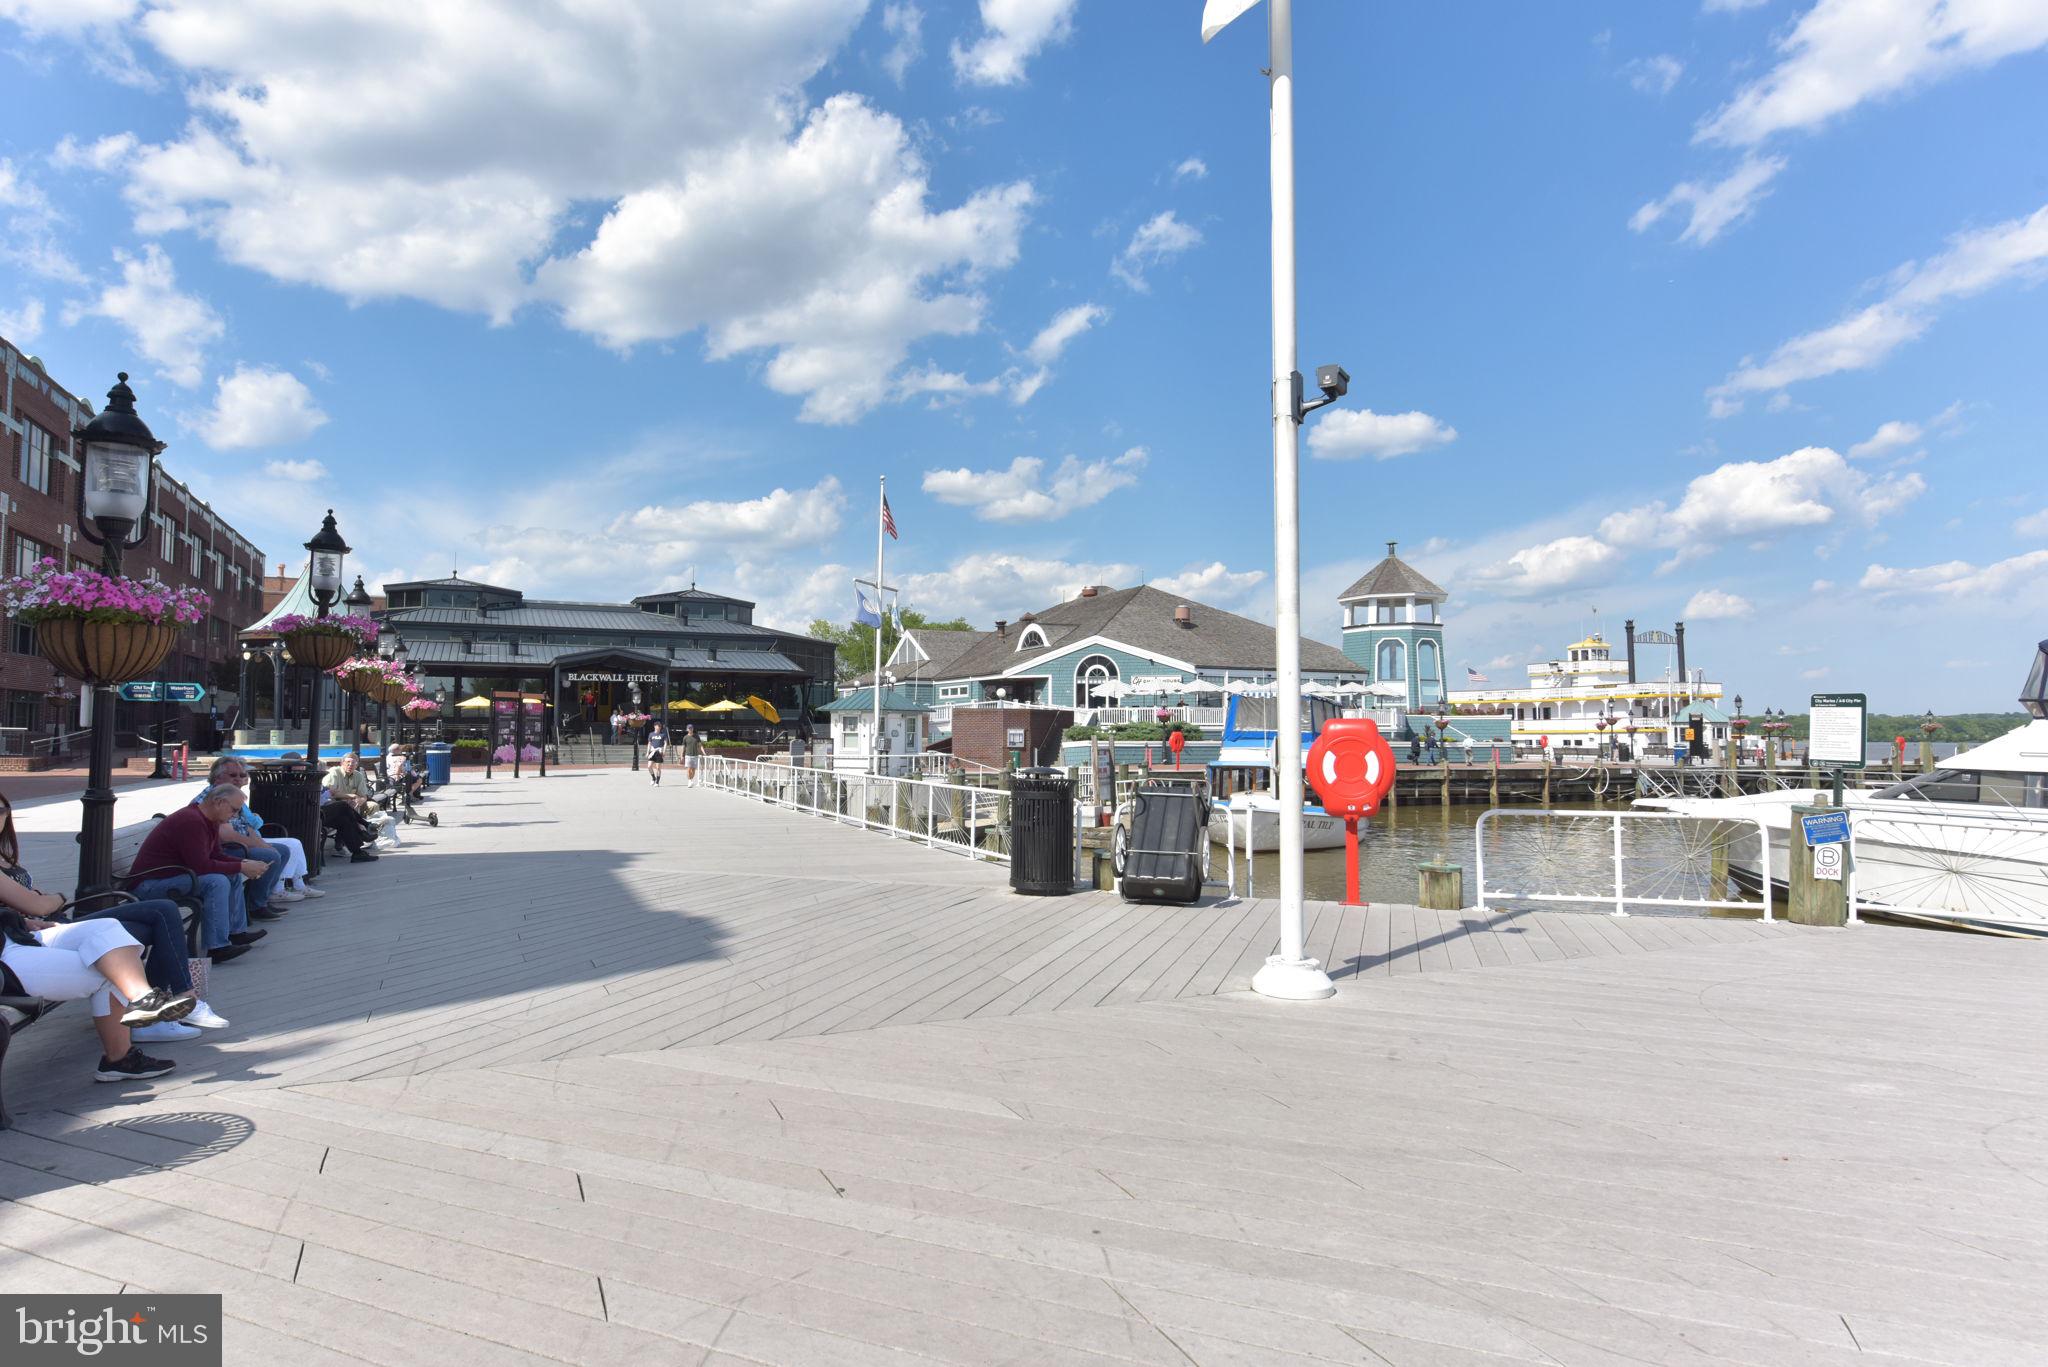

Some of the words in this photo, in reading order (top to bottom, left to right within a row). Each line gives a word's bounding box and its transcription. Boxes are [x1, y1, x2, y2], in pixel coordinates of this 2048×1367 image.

[567, 673, 624, 682] BLACKWALL
[626, 674, 659, 682] HITCH
[1805, 815, 1843, 825] WARNING
[1822, 849, 1835, 865] B
[1816, 867, 1839, 876] DOCK
